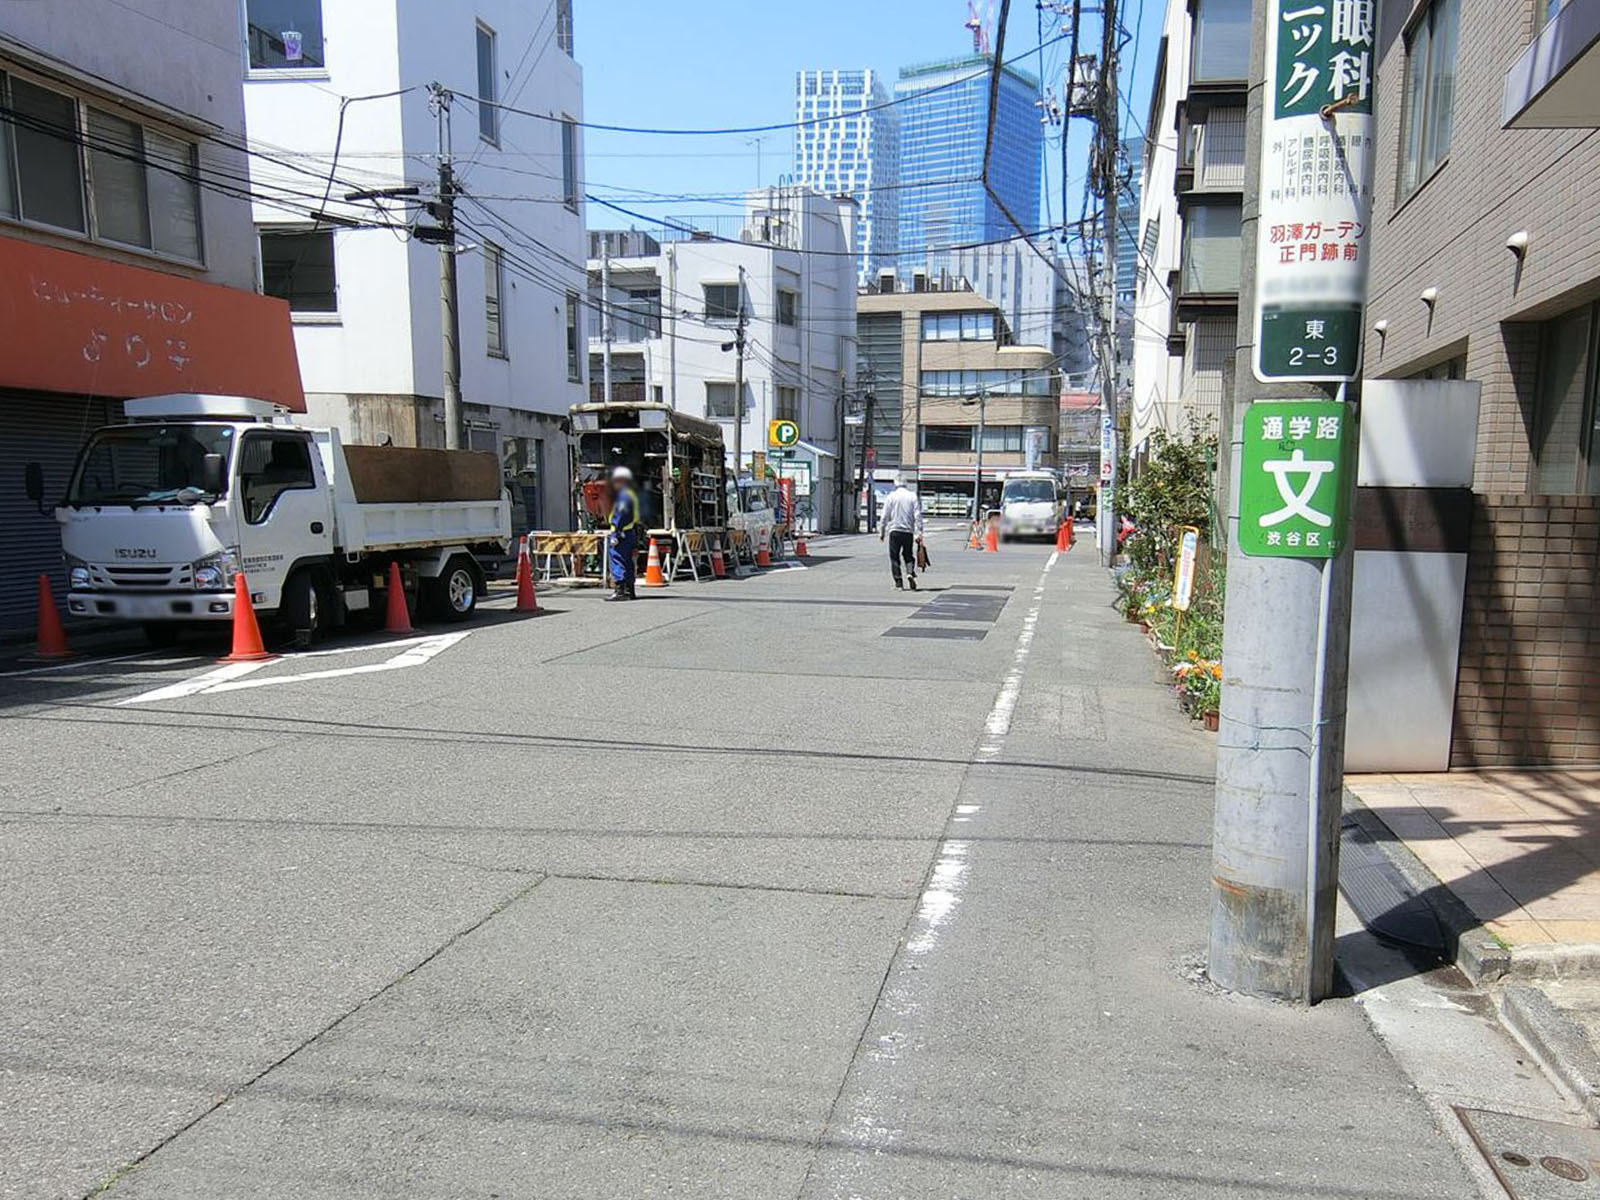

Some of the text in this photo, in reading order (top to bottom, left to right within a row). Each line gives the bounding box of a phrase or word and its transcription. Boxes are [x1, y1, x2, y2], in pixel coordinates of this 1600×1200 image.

[1327, 0, 1375, 101] 眼科
[1285, 138, 1298, 199] アレルギー科
[1269, 220, 1367, 244] 羽澤ガーデン
[1279, 243, 1359, 264] 正門跡前
[1304, 319, 1325, 340] 東
[1289, 346, 1338, 366] 2-3
[781, 424, 794, 442] P
[1262, 416, 1340, 440] 通学路
[1258, 449, 1335, 528] 文
[1266, 531, 1321, 547] 渋谷区
[115, 547, 157, 559] ISUZU
